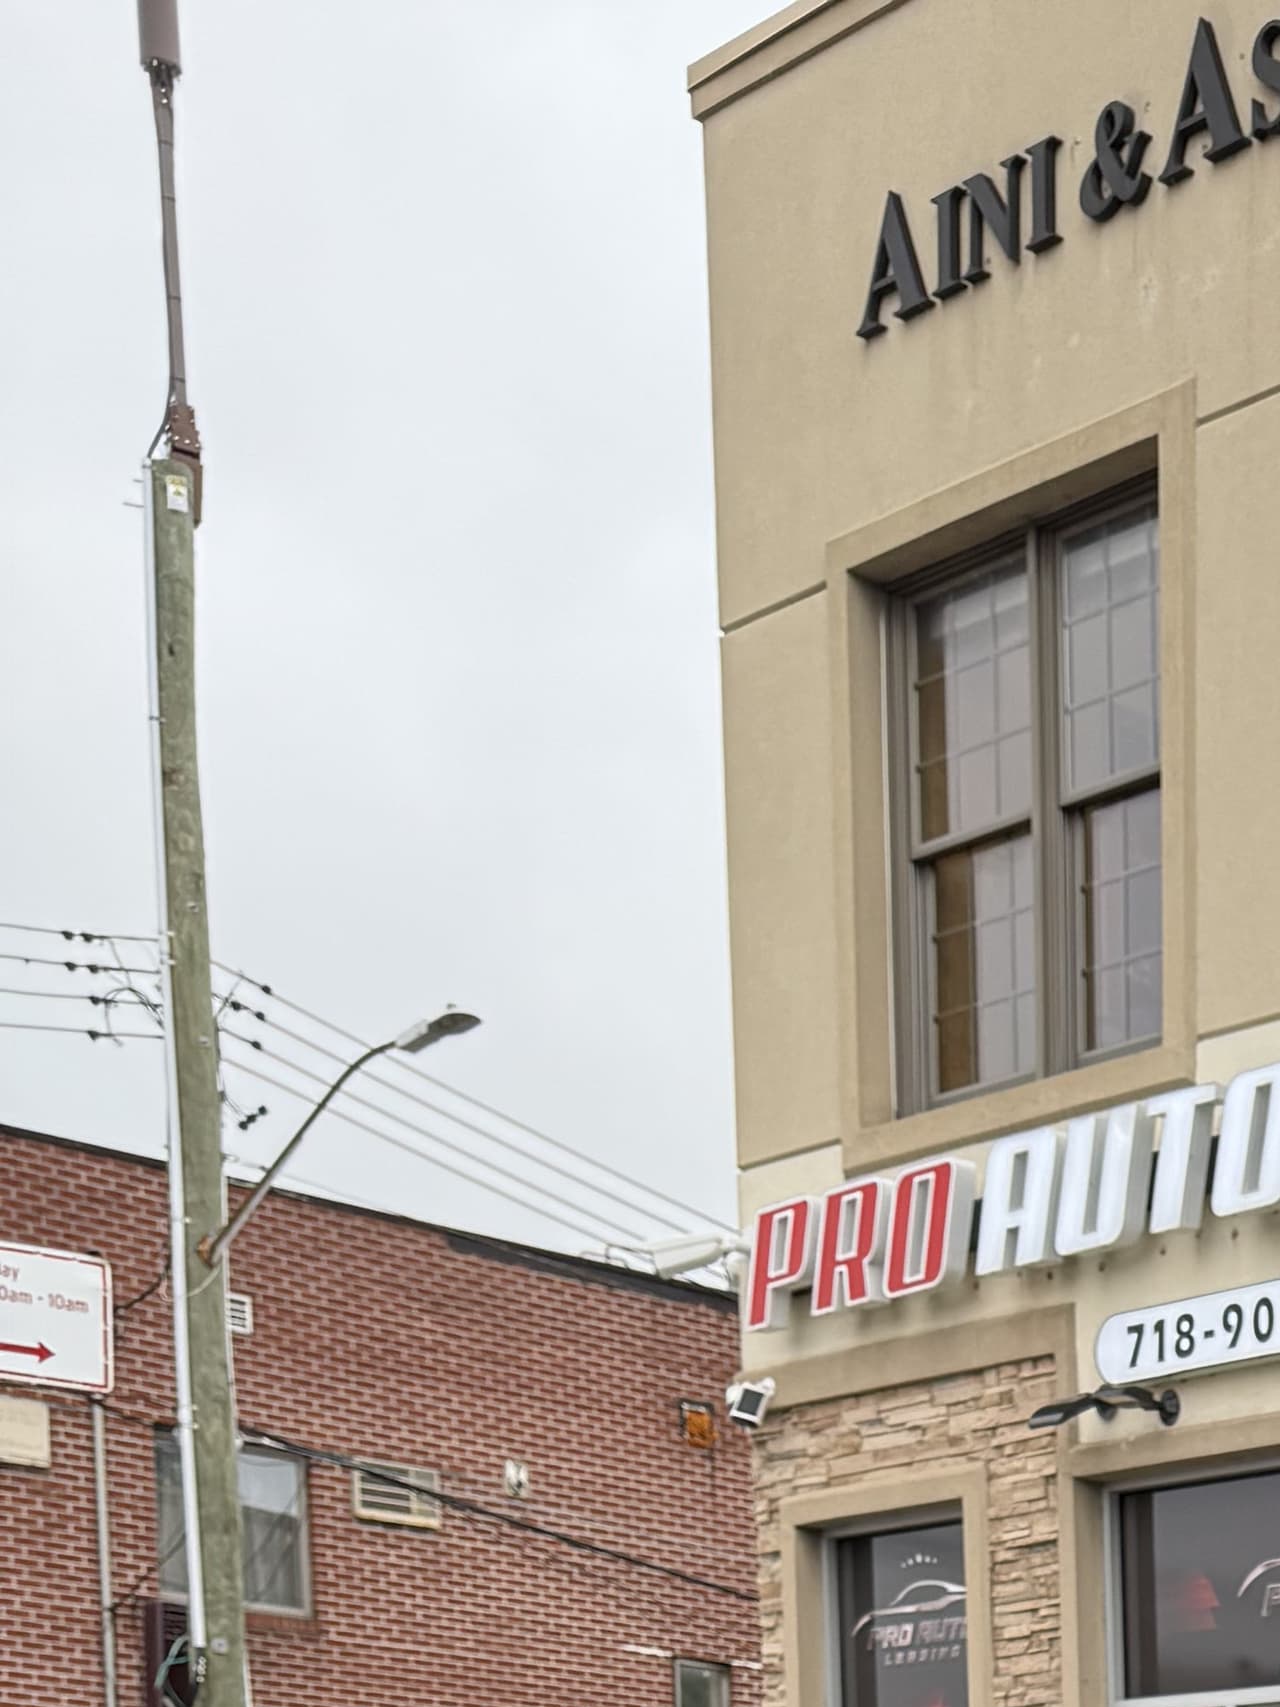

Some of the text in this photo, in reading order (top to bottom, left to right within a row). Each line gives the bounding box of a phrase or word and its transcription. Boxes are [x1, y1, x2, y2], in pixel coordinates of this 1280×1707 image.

[856, 135, 1063, 339] AINI
[1080, 100, 1152, 223] &
[0, 1264, 20, 1282] ay
[748, 1158, 976, 1331] PRO
[866, 1616, 967, 1651] PRO AUT
